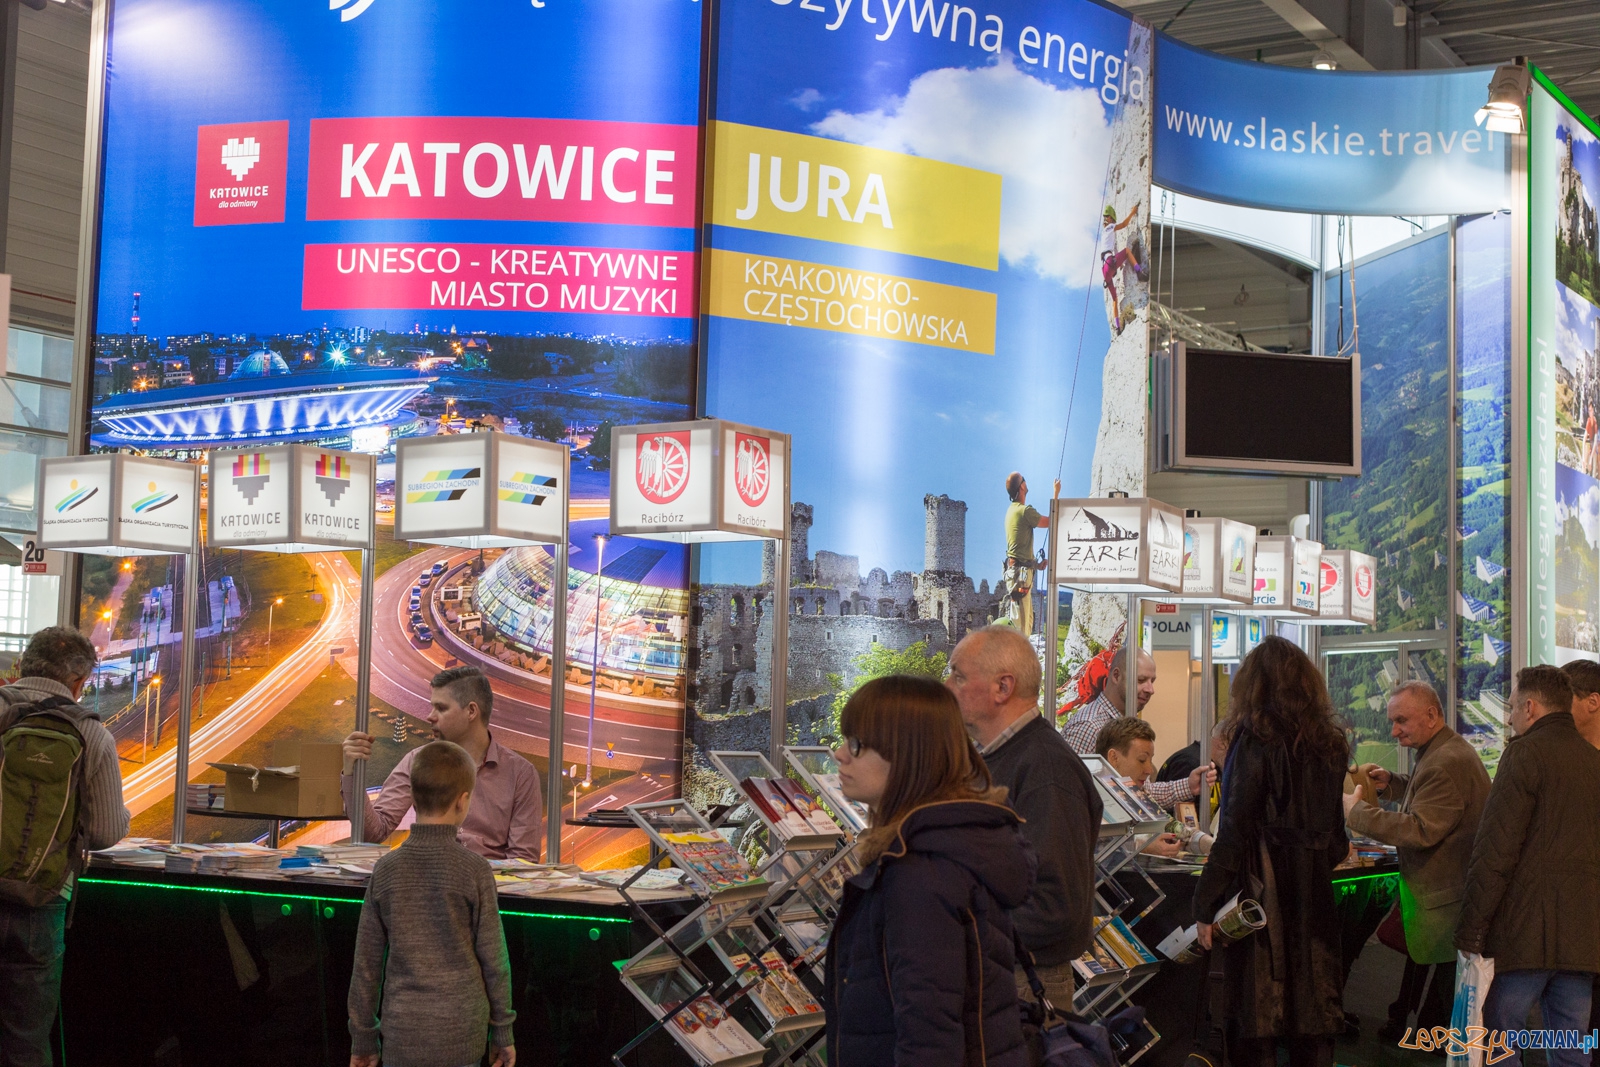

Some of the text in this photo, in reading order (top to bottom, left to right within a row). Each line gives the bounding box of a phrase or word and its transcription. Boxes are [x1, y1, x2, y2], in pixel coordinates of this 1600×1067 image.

[1017, 25, 1145, 105] energia
[1165, 104, 1494, 156] www.slaskie.travel
[340, 142, 675, 205] KATOWICE
[736, 152, 894, 229] JURA
[209, 185, 269, 199] KATOWICE
[218, 199, 258, 209] dla odmiany
[336, 247, 461, 274] UNESCO
[490, 249, 678, 281] KREATYWNE
[430, 280, 677, 315] MIASTO MUZYKI
[744, 258, 919, 306] KRAKOWSKO-
[743, 289, 969, 346] CZĘSTOCHOWSKA
[407, 478, 480, 491] SUBREGION ZACHODNI
[499, 480, 556, 496] SUBREGION ZACHODNI
[1536, 337, 1551, 665] .orlegniazda.pl
[220, 512, 281, 528] KATOWICE
[304, 512, 360, 530] KATOWICE
[641, 512, 684, 524] Racibórz
[737, 513, 766, 528] Racibórz
